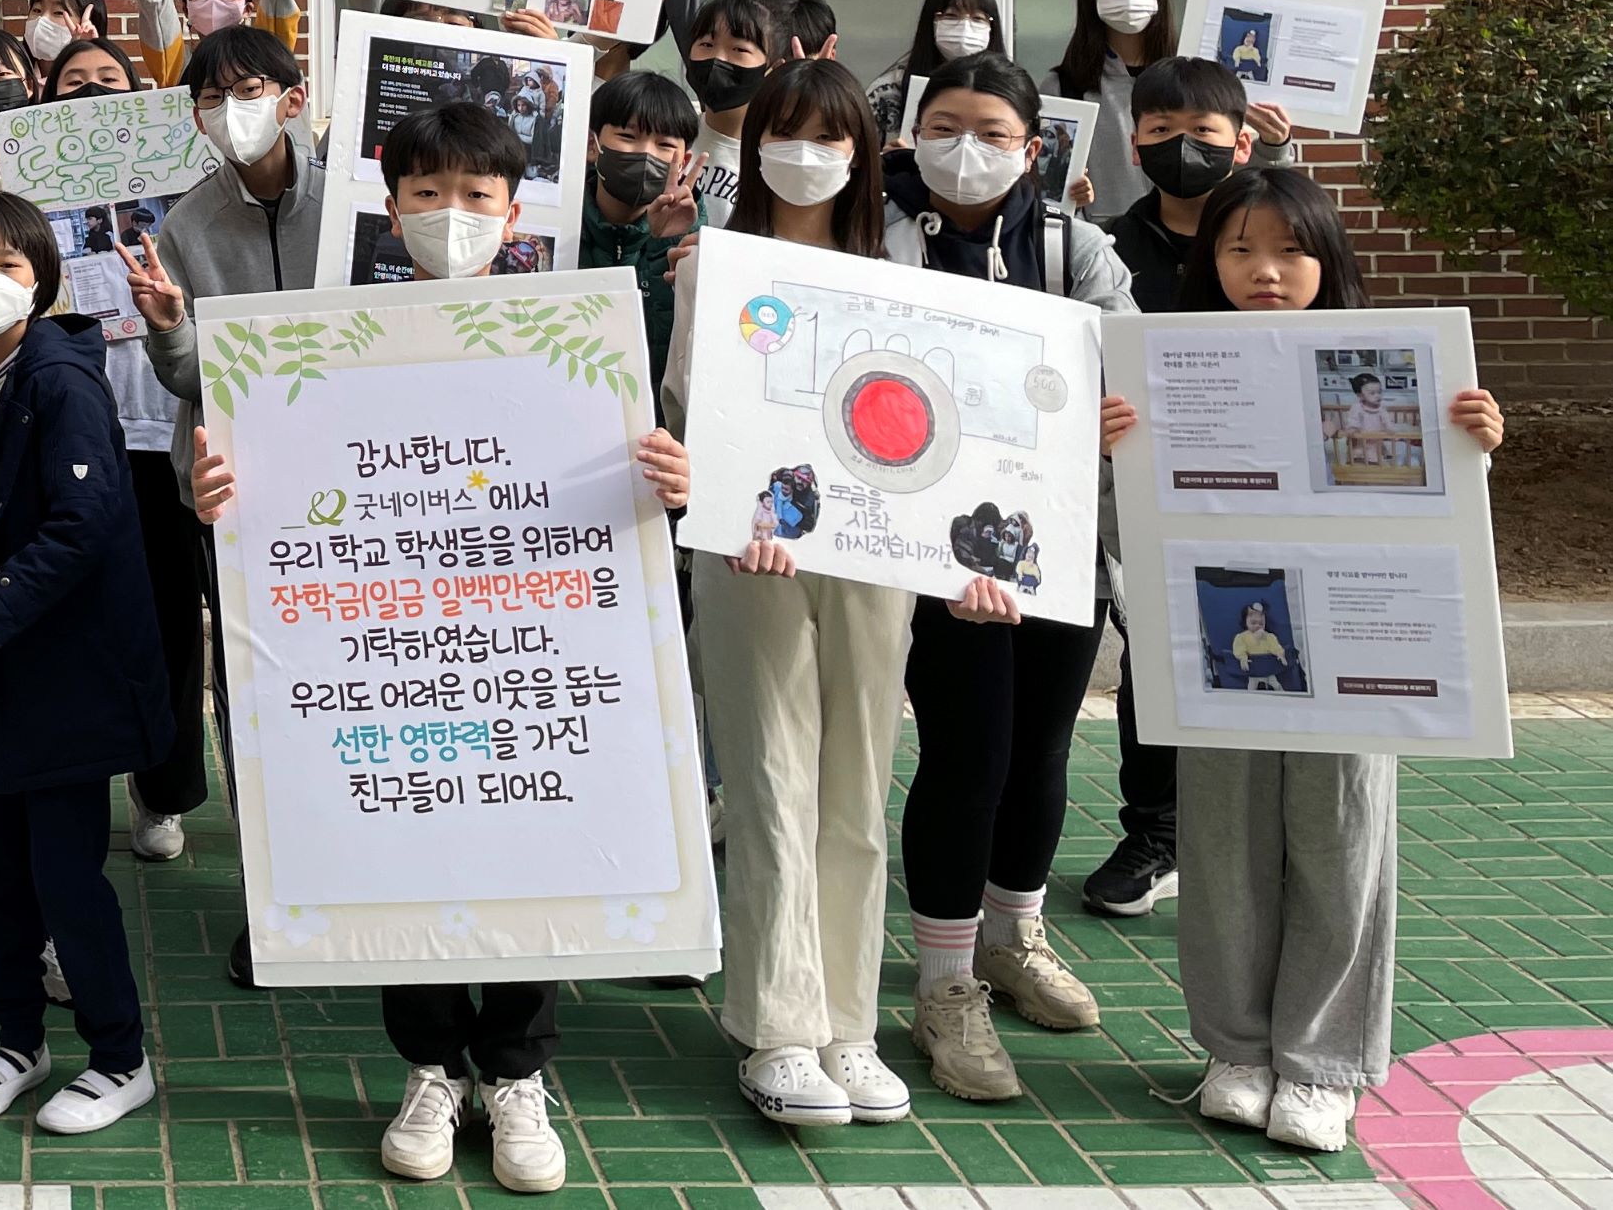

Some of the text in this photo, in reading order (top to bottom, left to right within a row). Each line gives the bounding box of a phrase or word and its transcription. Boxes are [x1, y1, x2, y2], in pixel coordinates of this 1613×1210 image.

[11, 105, 83, 140] 어려운
[91, 97, 150, 126] 친구들을
[396, 266, 415, 274] 순간에
[347, 434, 512, 478] 감사합니다.
[354, 481, 550, 520] 굿네이버스 에서
[827, 484, 885, 515] 모금을
[846, 510, 891, 533] 시작
[269, 523, 613, 575] 우리 학교 학생들을 위하여
[271, 566, 620, 624] 장학금(일금 일백만원정)을
[340, 624, 560, 666] 기탁하였습니다.
[290, 665, 622, 719] 우리도 어려운 이웃을 돕는
[331, 715, 590, 766] 선한 영향력을 가진
[349, 770, 575, 815] 친구들이 되어요.
